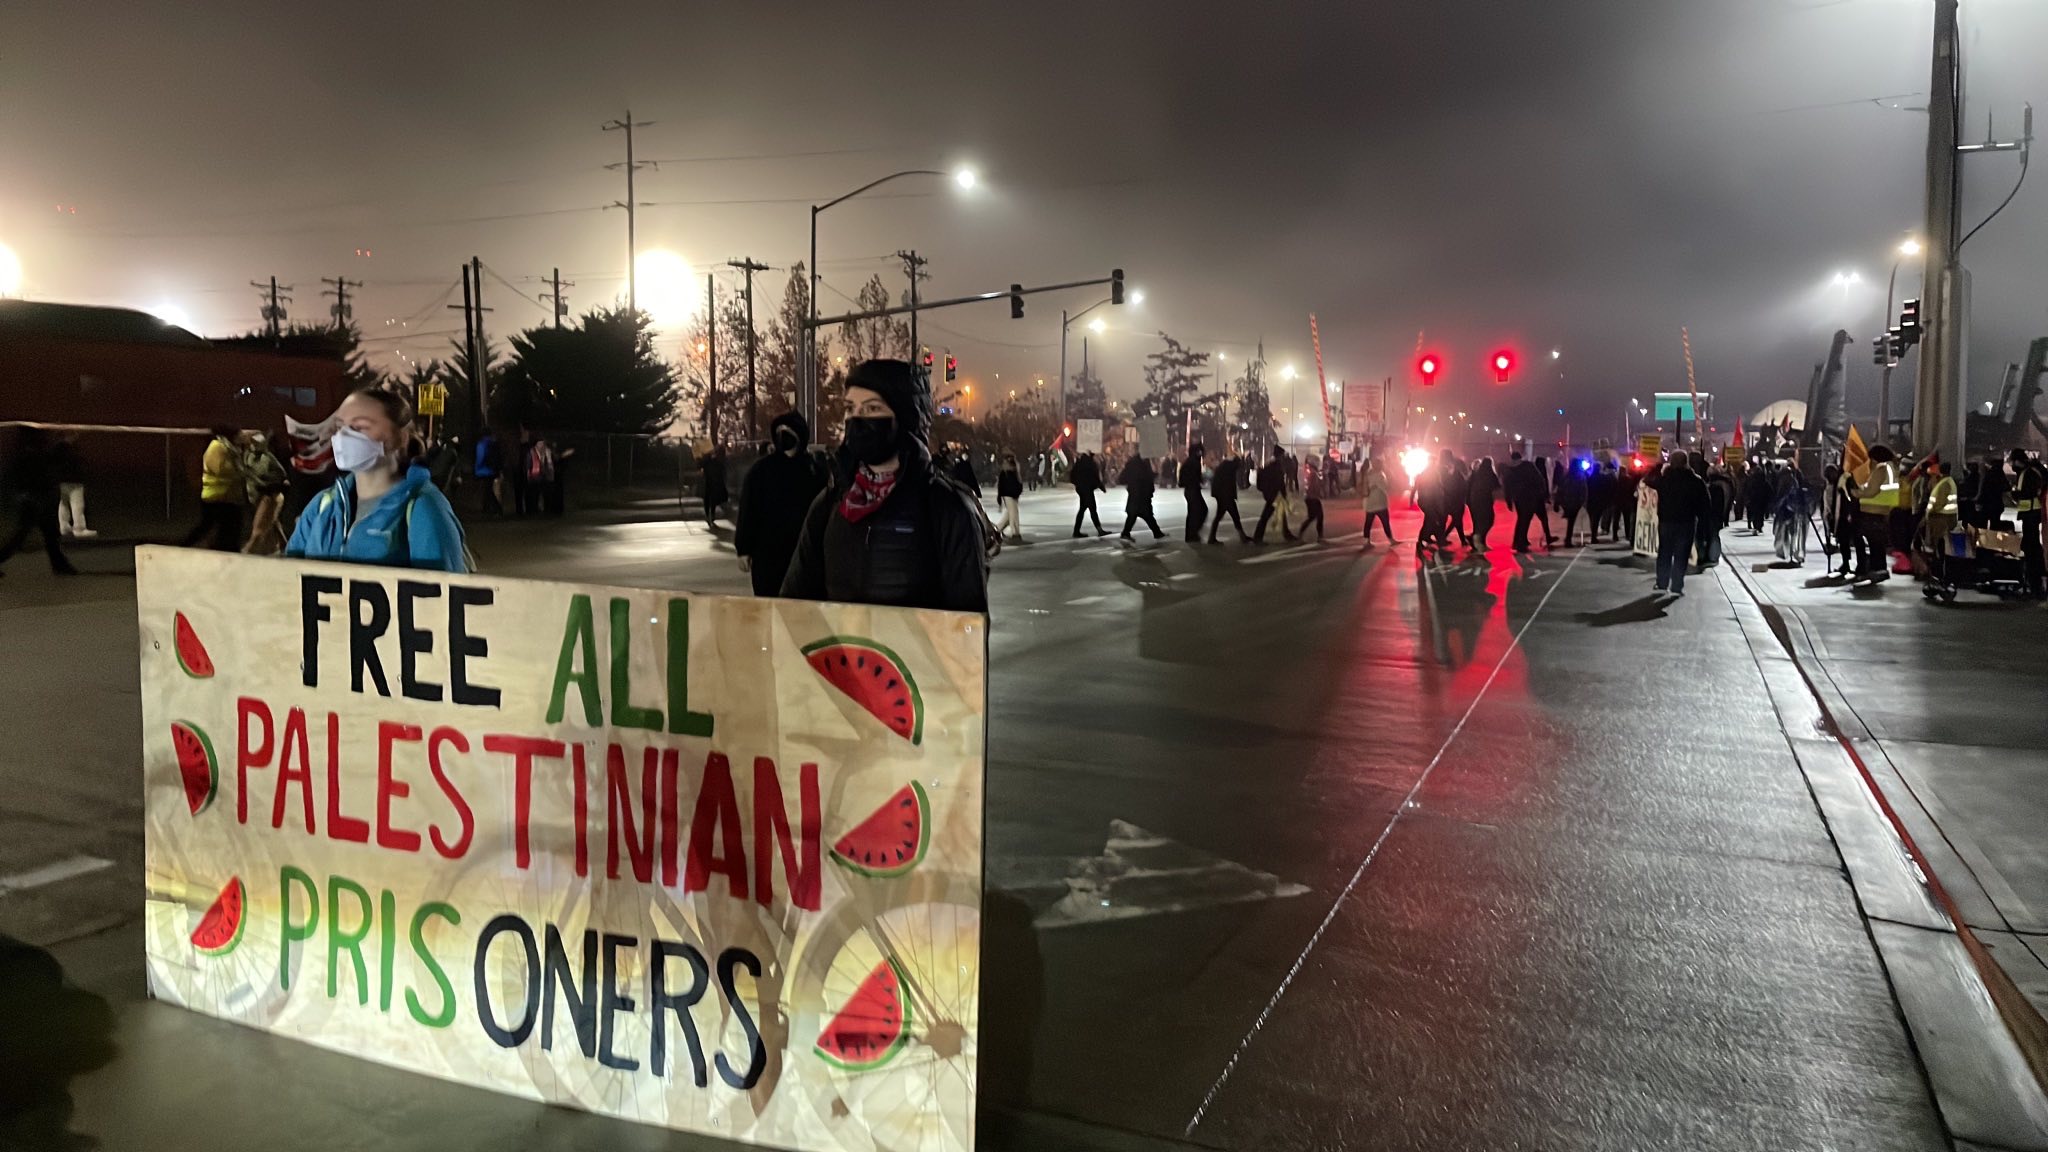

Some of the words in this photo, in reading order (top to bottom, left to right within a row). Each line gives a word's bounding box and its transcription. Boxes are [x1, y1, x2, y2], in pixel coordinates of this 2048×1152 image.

[301, 574, 502, 708] FREE
[546, 594, 715, 738] ALL
[236, 696, 822, 912] PALESTINIAN
[280, 865, 767, 1091] PRISONERS
